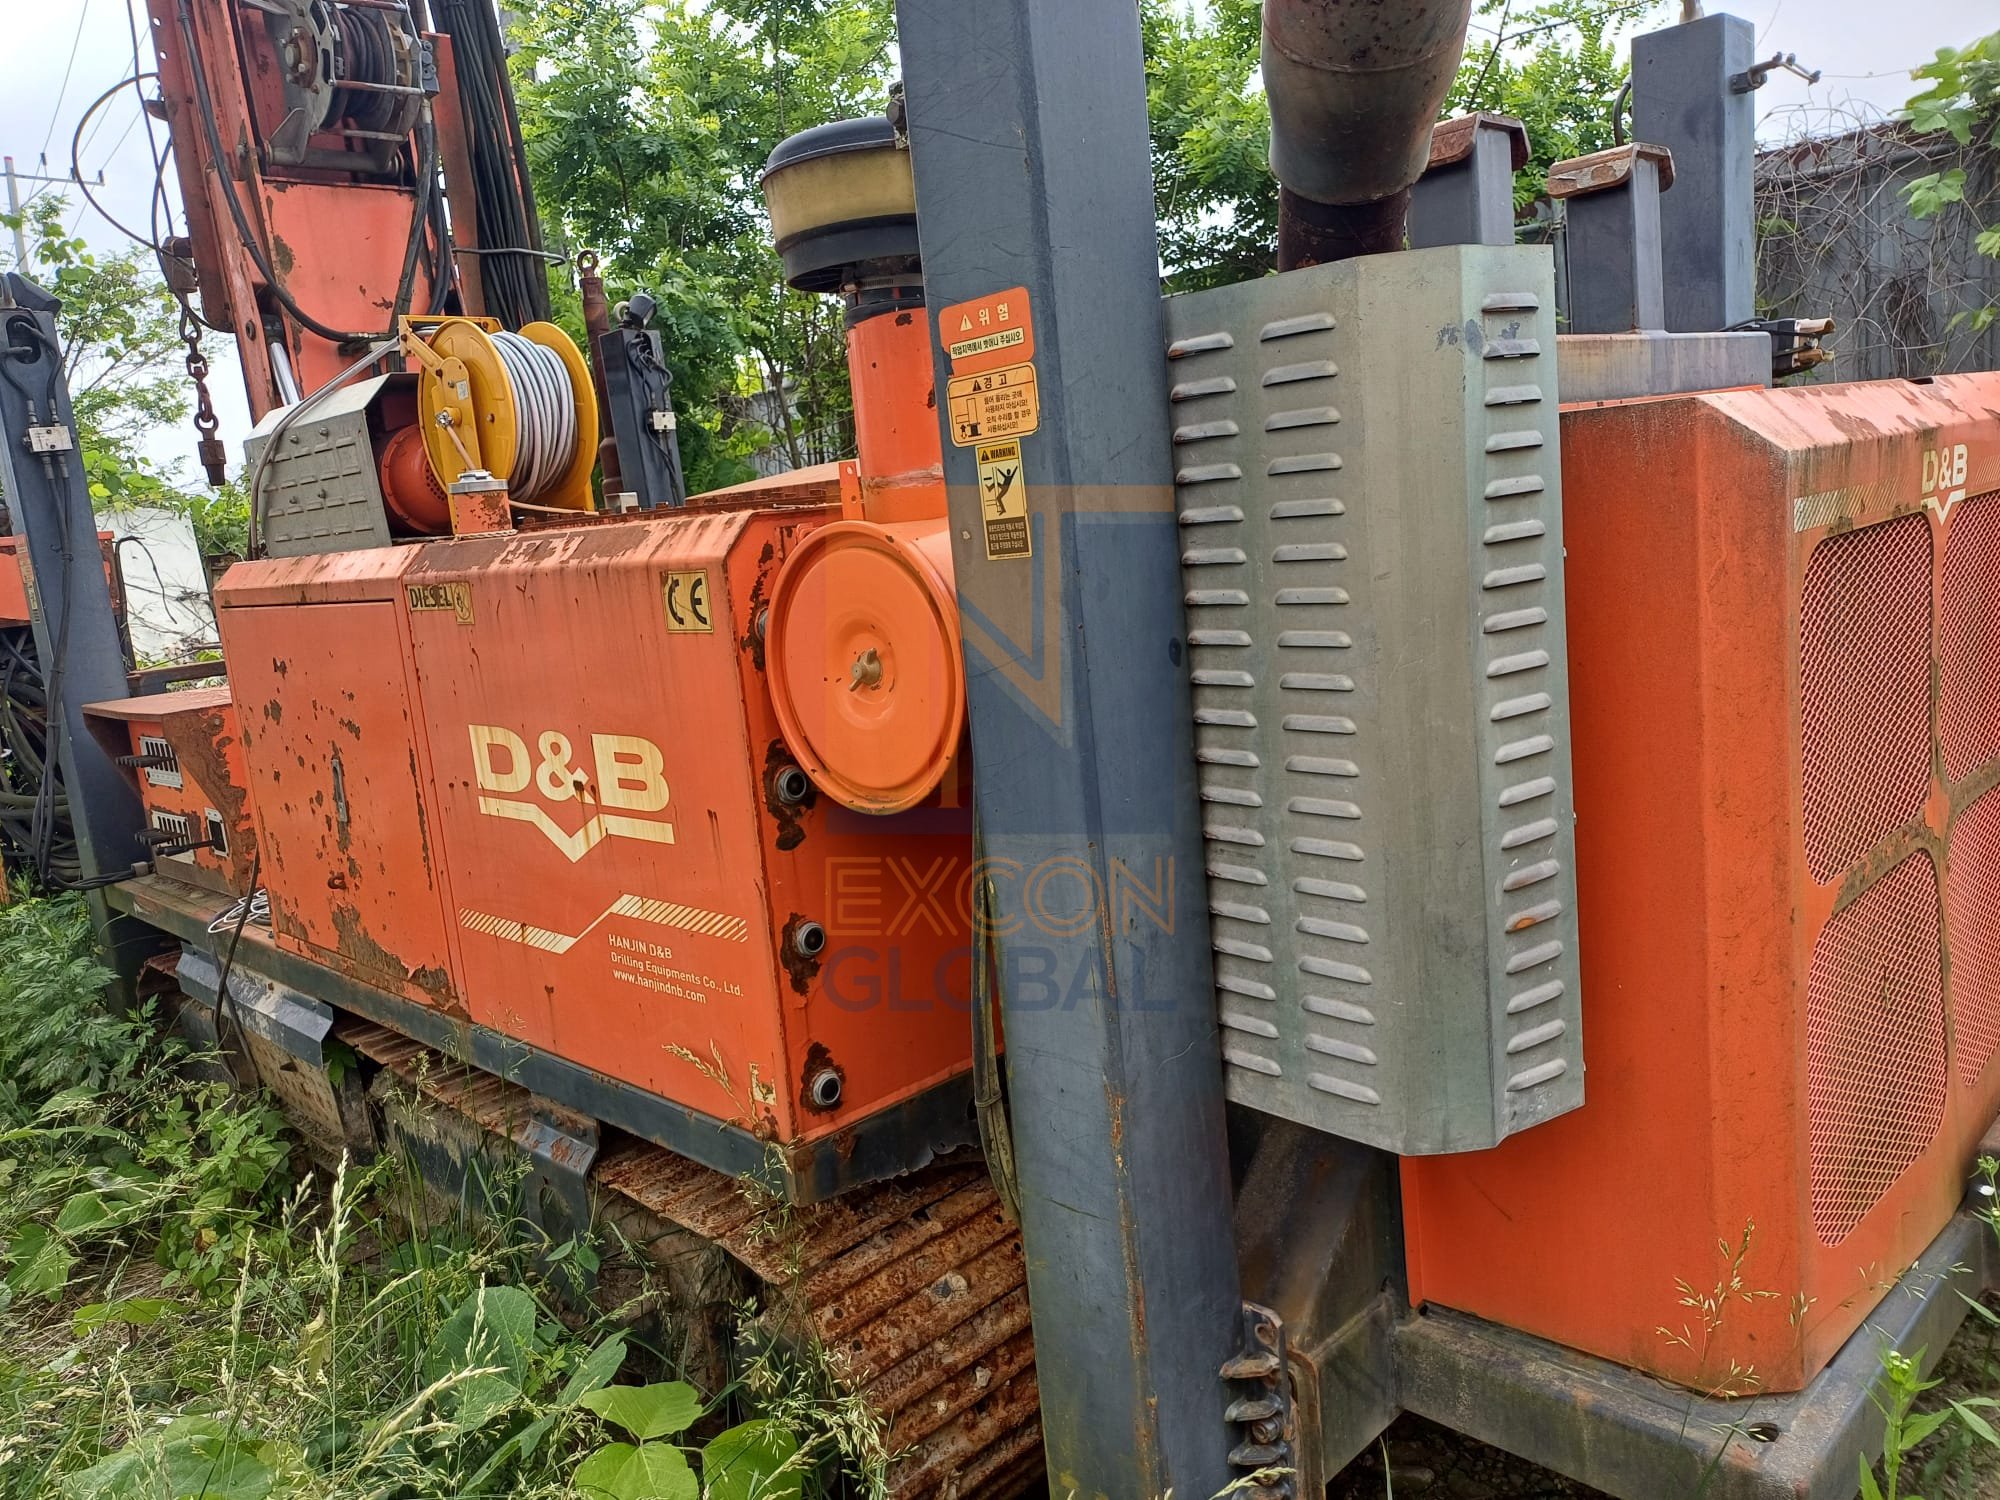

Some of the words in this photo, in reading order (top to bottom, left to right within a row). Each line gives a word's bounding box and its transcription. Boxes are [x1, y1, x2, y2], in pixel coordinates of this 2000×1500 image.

[990, 446, 1016, 459] WARNING
[1922, 444, 1968, 494] D&B
[409, 585, 453, 609] DIESEL
[667, 576, 709, 626] CE
[468, 724, 670, 812] D&B
[608, 933, 648, 954] HANJIN
[649, 943, 672, 959] D&B
[611, 951, 644, 971] Drilling
[646, 960, 701, 985] Equipments
[703, 975, 722, 992] Co.,
[724, 981, 744, 997] Ltd.
[613, 969, 707, 1004] www.hanjindnb.com
